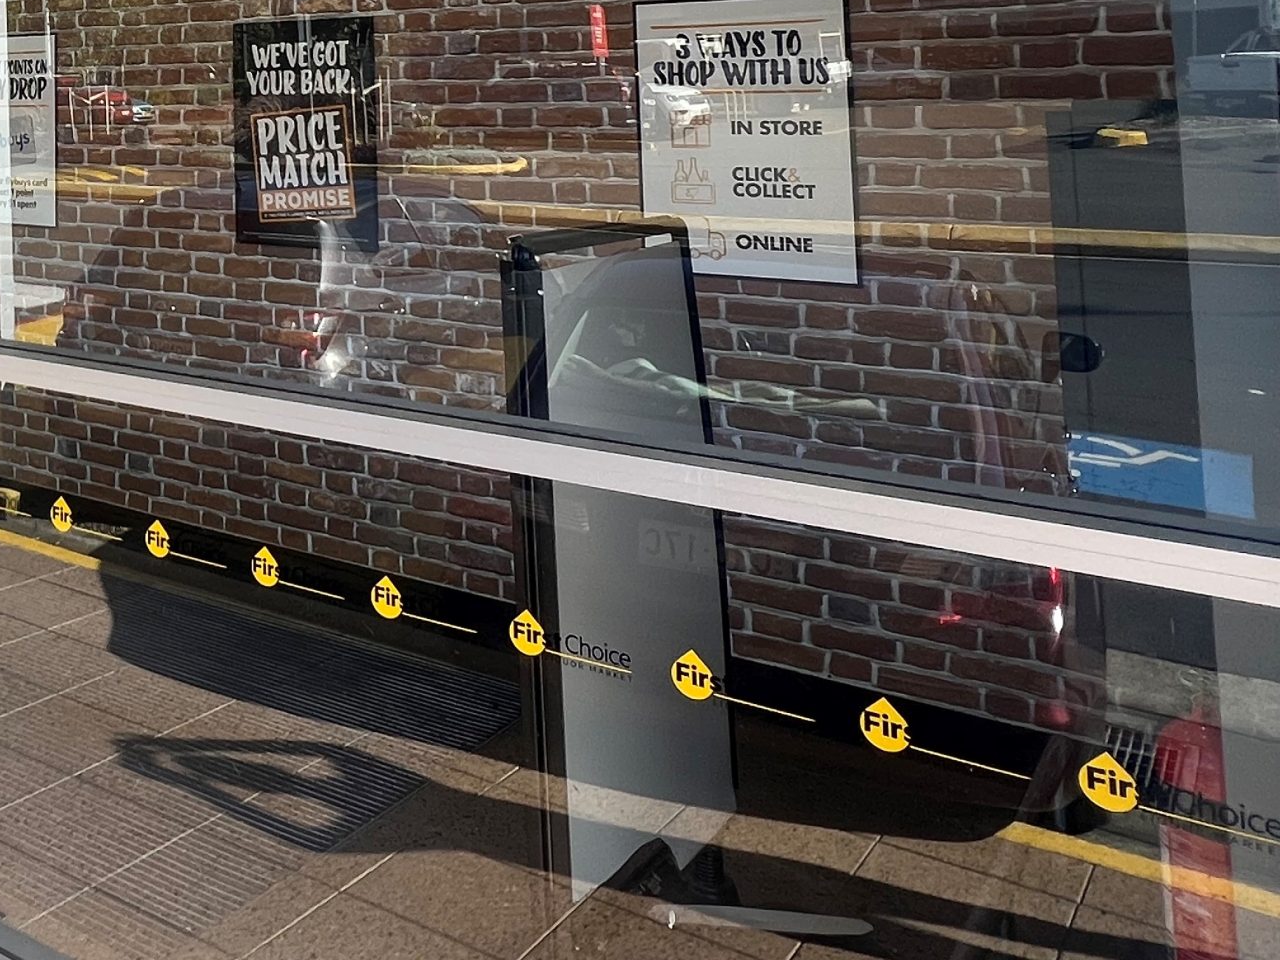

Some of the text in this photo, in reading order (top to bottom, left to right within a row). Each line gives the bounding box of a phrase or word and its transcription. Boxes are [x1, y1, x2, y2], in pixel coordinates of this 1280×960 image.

[251, 40, 350, 69] WE'VE GOT
[676, 33, 691, 59] 3
[772, 30, 802, 57] TO
[35, 59, 48, 74] ON
[653, 56, 830, 86] SHOP WITH US
[9, 76, 47, 100] DROP
[246, 68, 351, 95] YOUR BACK
[257, 111, 344, 156] PRICE
[731, 120, 823, 136] IN STORE
[260, 151, 348, 190] MATCH
[262, 189, 351, 210] PROMISE
[733, 183, 816, 200] COLLECT
[735, 234, 814, 253] ONLINE
[565, 634, 632, 668] Choice
[676, 661, 724, 692] Firs
